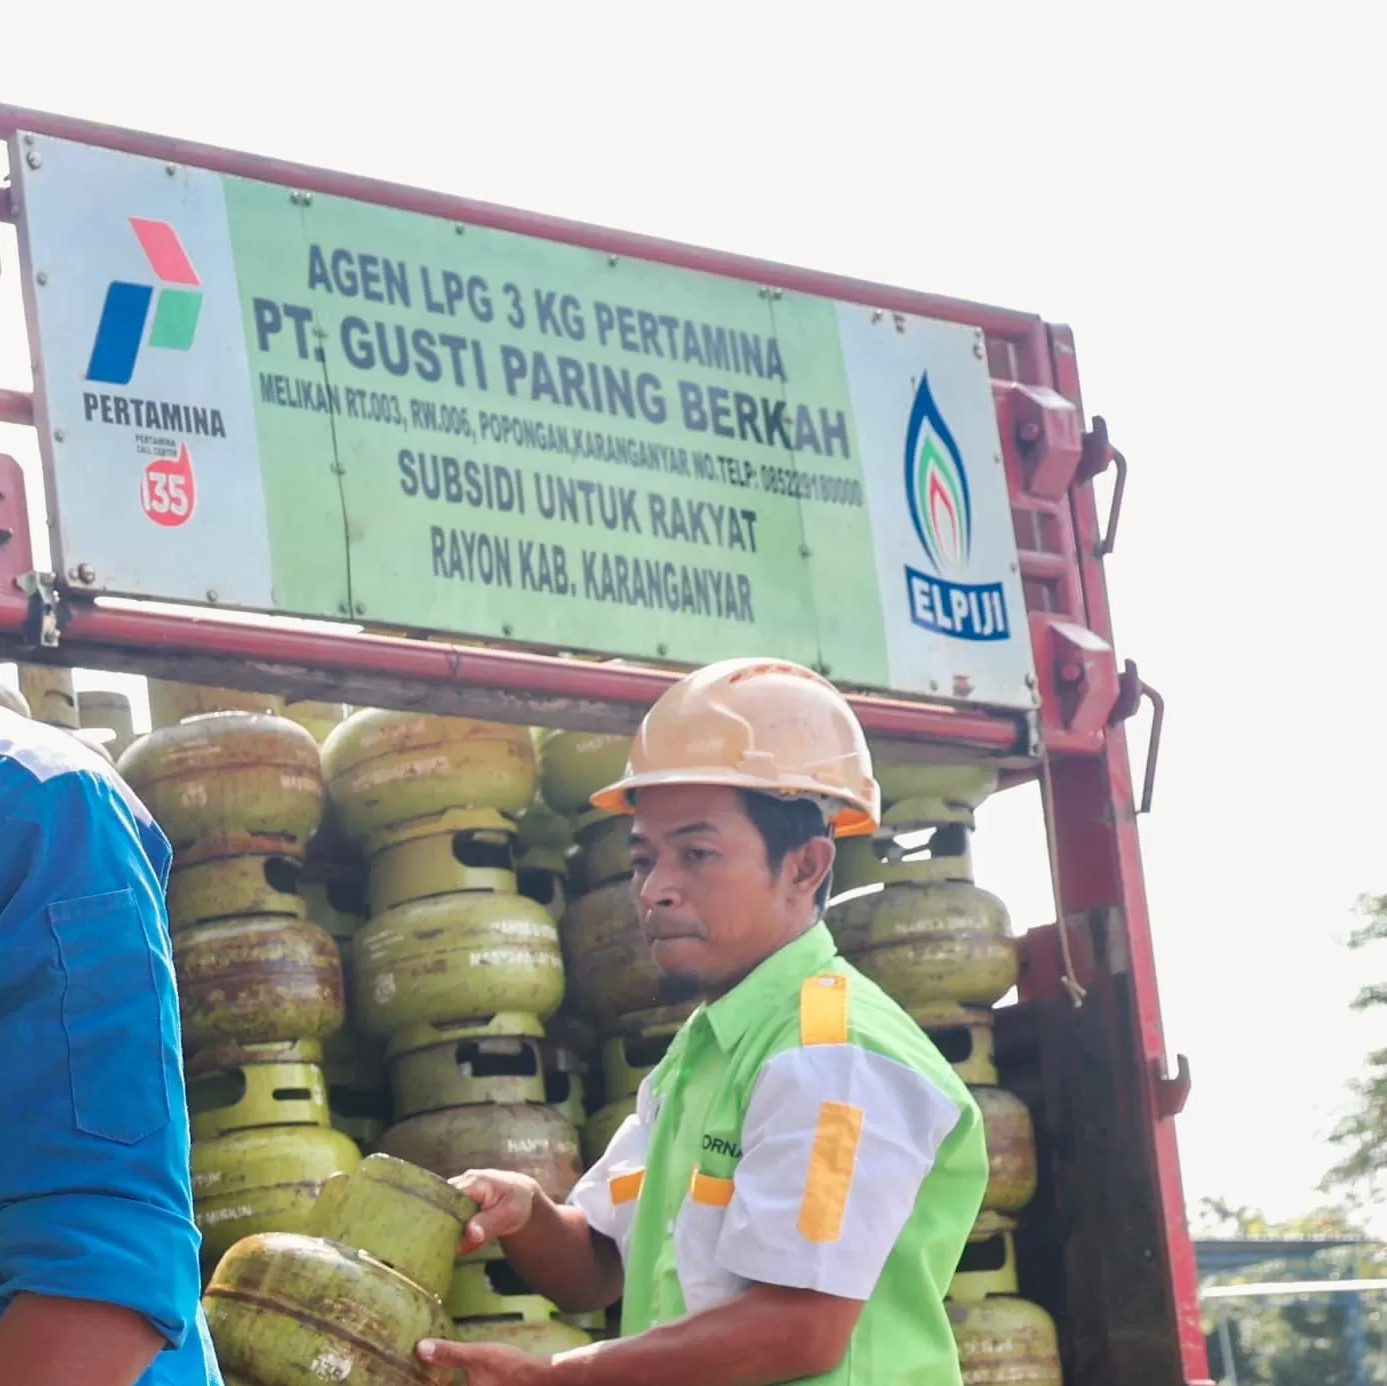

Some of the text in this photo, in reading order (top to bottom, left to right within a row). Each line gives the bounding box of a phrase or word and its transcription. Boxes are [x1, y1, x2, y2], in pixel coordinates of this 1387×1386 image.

[308, 243, 789, 383] AGEN LPG 3 KG PERTAMINA
[83, 391, 227, 438] PERTAMINA
[252, 296, 851, 460] PT. GUSTI PARING BERKAH
[258, 371, 342, 416] MELIKAN
[141, 470, 189, 516] 135
[396, 448, 759, 554] SUBSIDI UNTUK RAKYAT
[429, 524, 757, 624] RAYON KAB. KARANGANYAR
[909, 574, 1006, 637] ELPIJI
